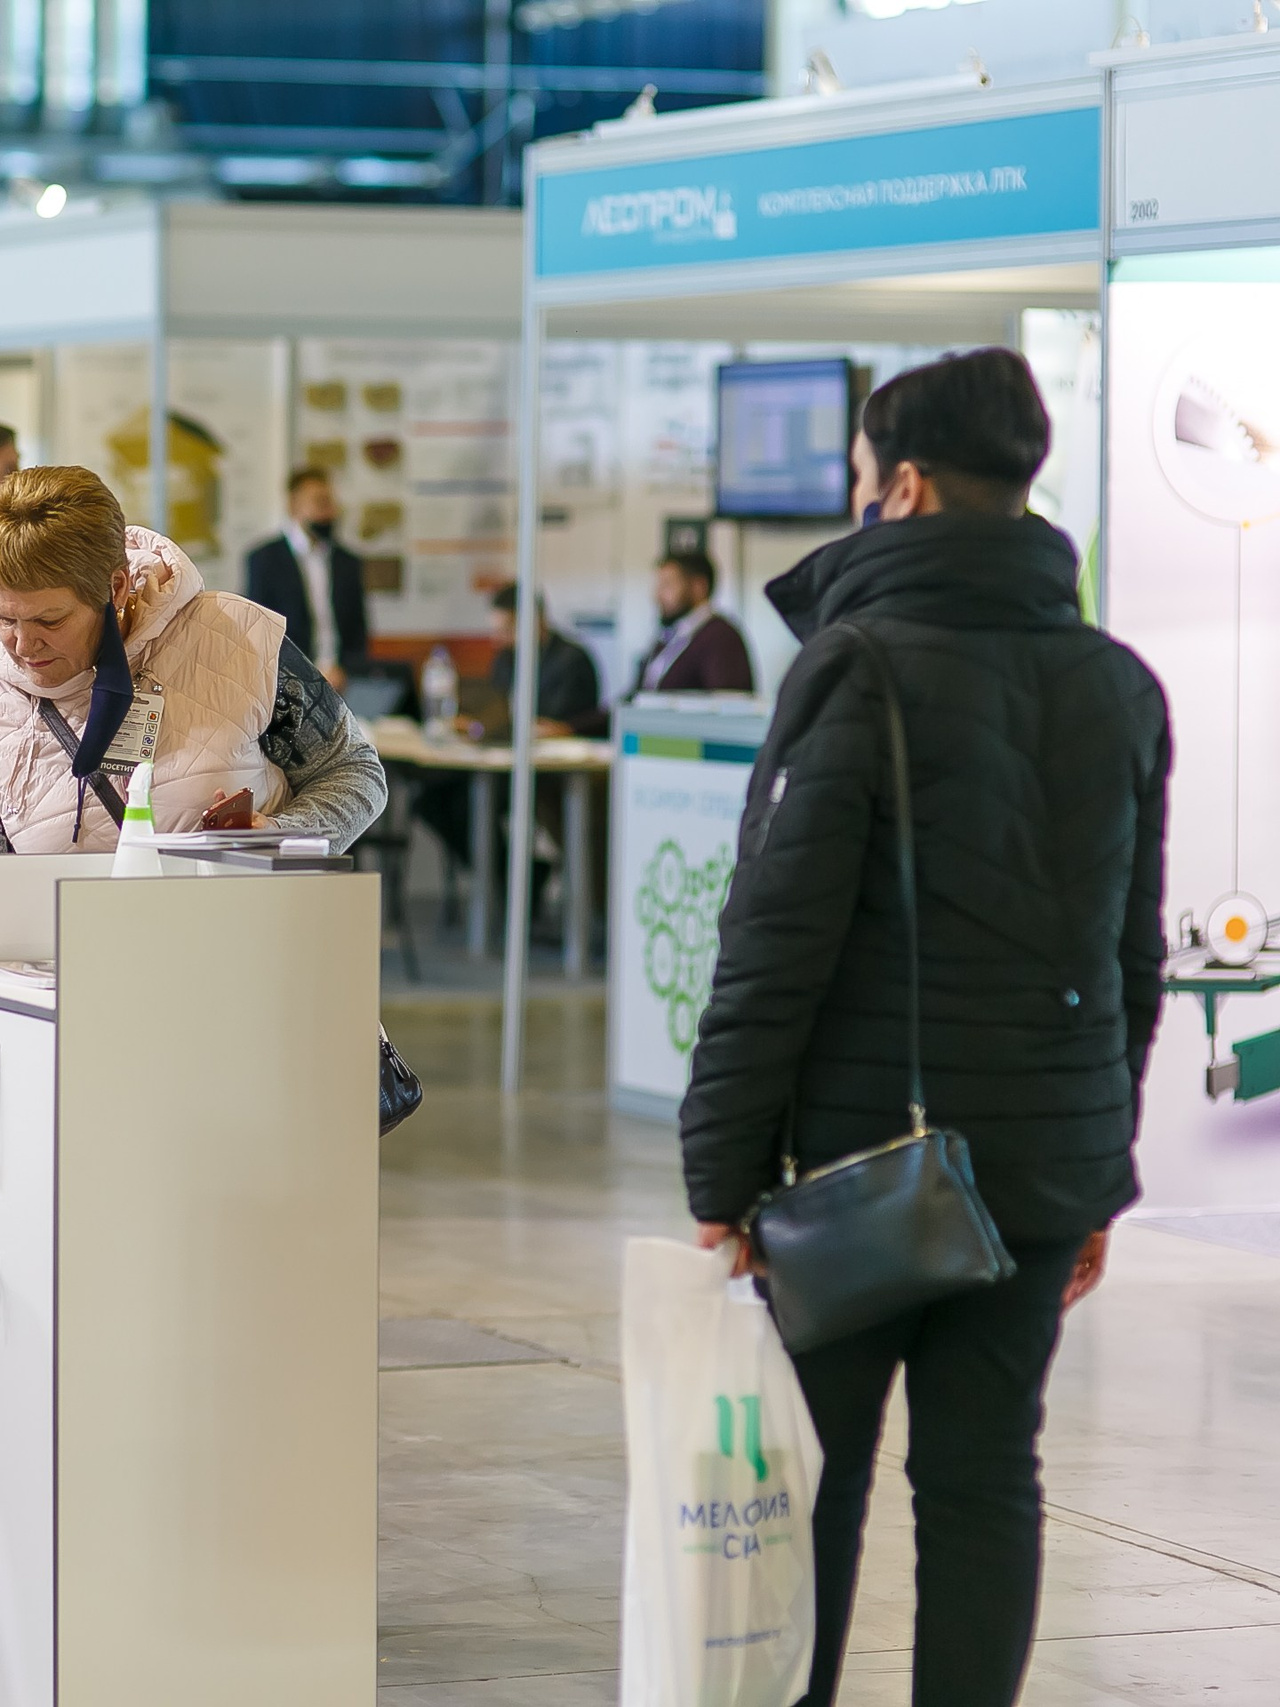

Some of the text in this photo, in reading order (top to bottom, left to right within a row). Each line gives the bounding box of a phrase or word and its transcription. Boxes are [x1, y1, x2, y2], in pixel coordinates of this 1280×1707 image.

[989, 165, 1027, 194] ЛПК
[1130, 199, 1159, 220] 2002
[100, 762, 134, 773] ПОСЕТИТ
[679, 1491, 790, 1529] МЕЛОИЯ
